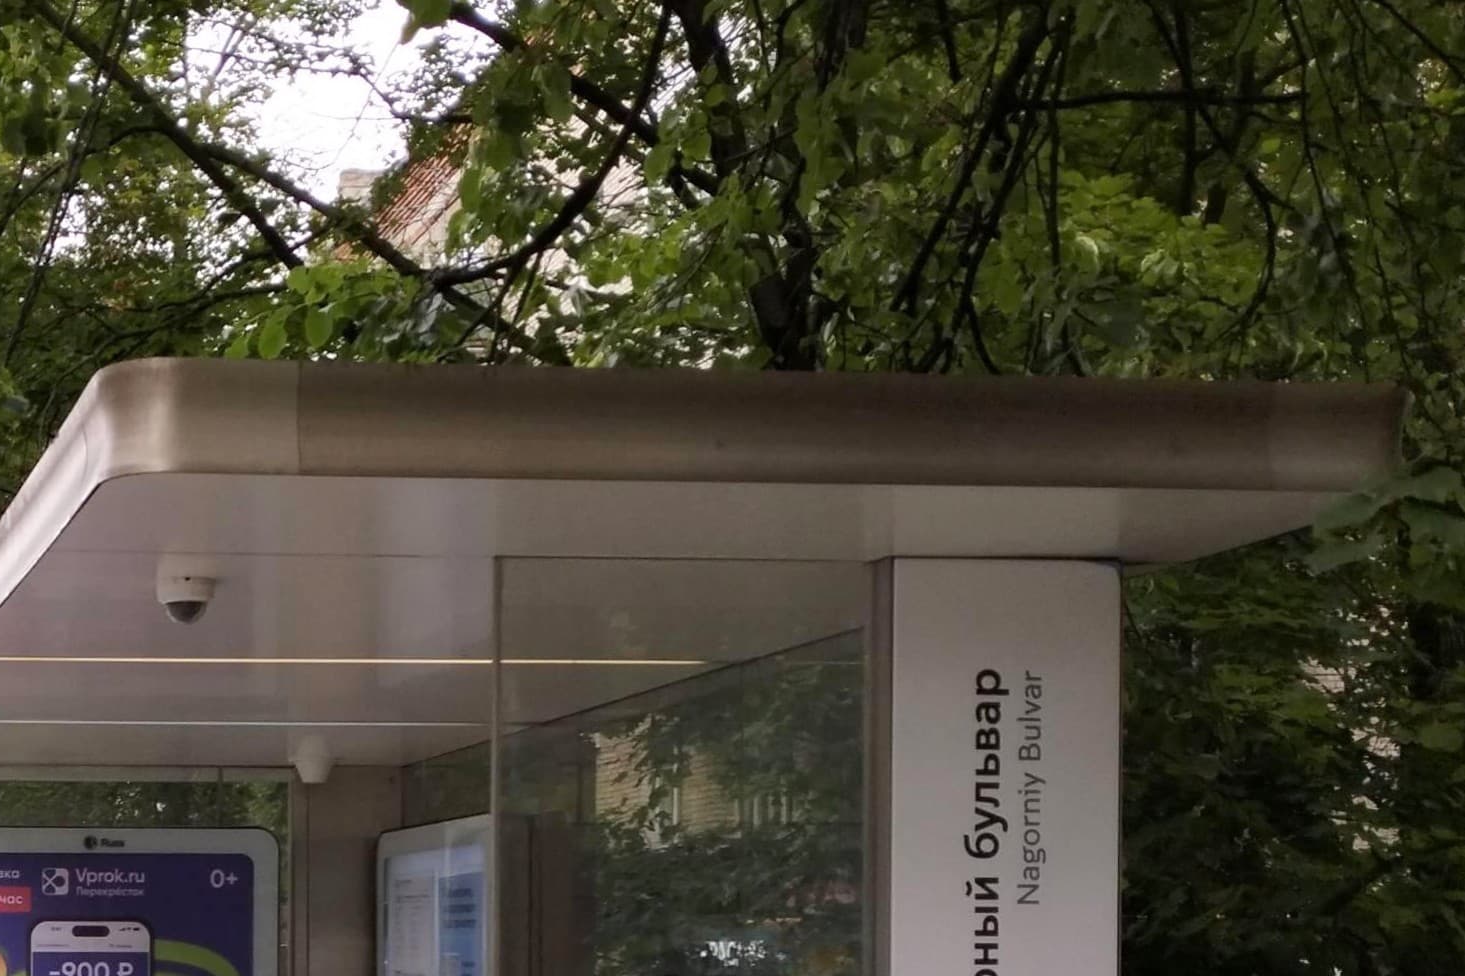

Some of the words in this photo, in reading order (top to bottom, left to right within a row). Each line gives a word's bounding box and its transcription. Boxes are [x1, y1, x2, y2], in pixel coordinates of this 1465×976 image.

[1017, 671, 1043, 761] Bulvar
[964, 668, 1009, 859] бульвар
[1017, 772, 1046, 905] Nagorniy
[0, 895, 23, 905] час
[75, 867, 145, 887] Vprok.ru
[210, 869, 238, 888] 0+
